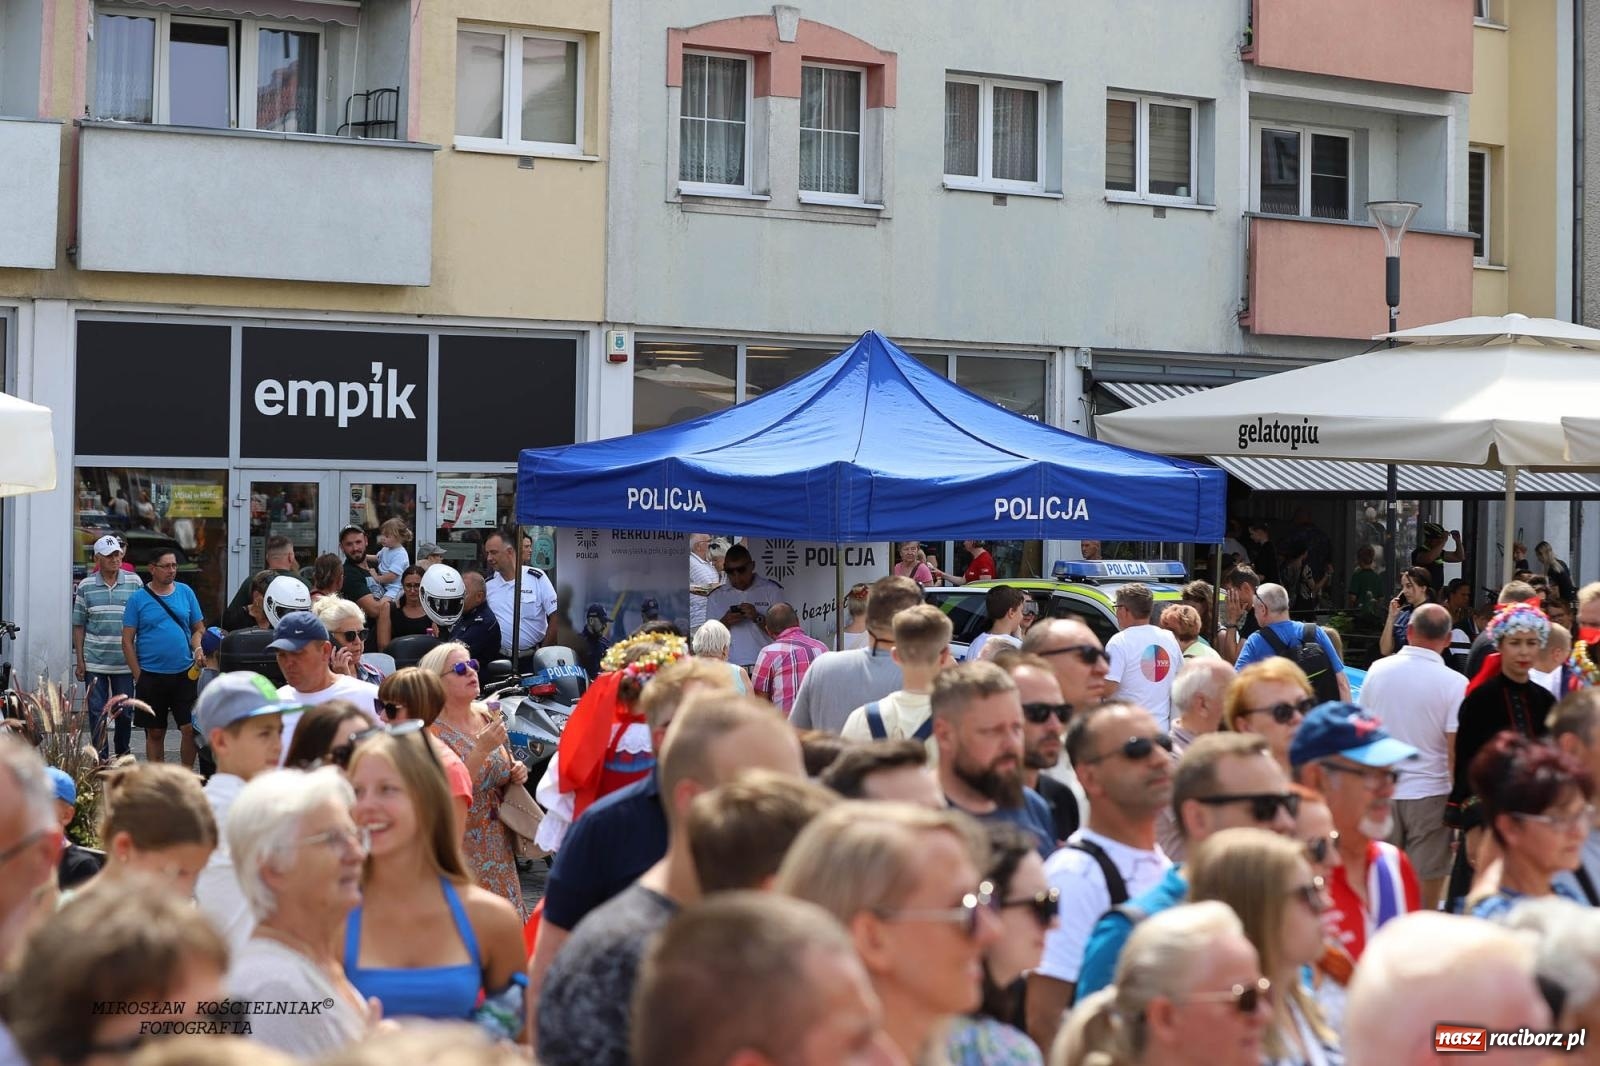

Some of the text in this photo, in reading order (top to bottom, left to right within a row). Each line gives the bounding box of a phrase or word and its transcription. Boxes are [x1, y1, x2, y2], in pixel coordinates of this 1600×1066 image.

[254, 362, 416, 427] empik
[1238, 417, 1319, 450] gelatopiu
[627, 487, 707, 513] POLICJA
[994, 496, 1089, 521] POLICJA
[576, 552, 599, 560] POLICJA
[805, 547, 875, 567] POLCJA
[1106, 562, 1148, 576] POLICJA
